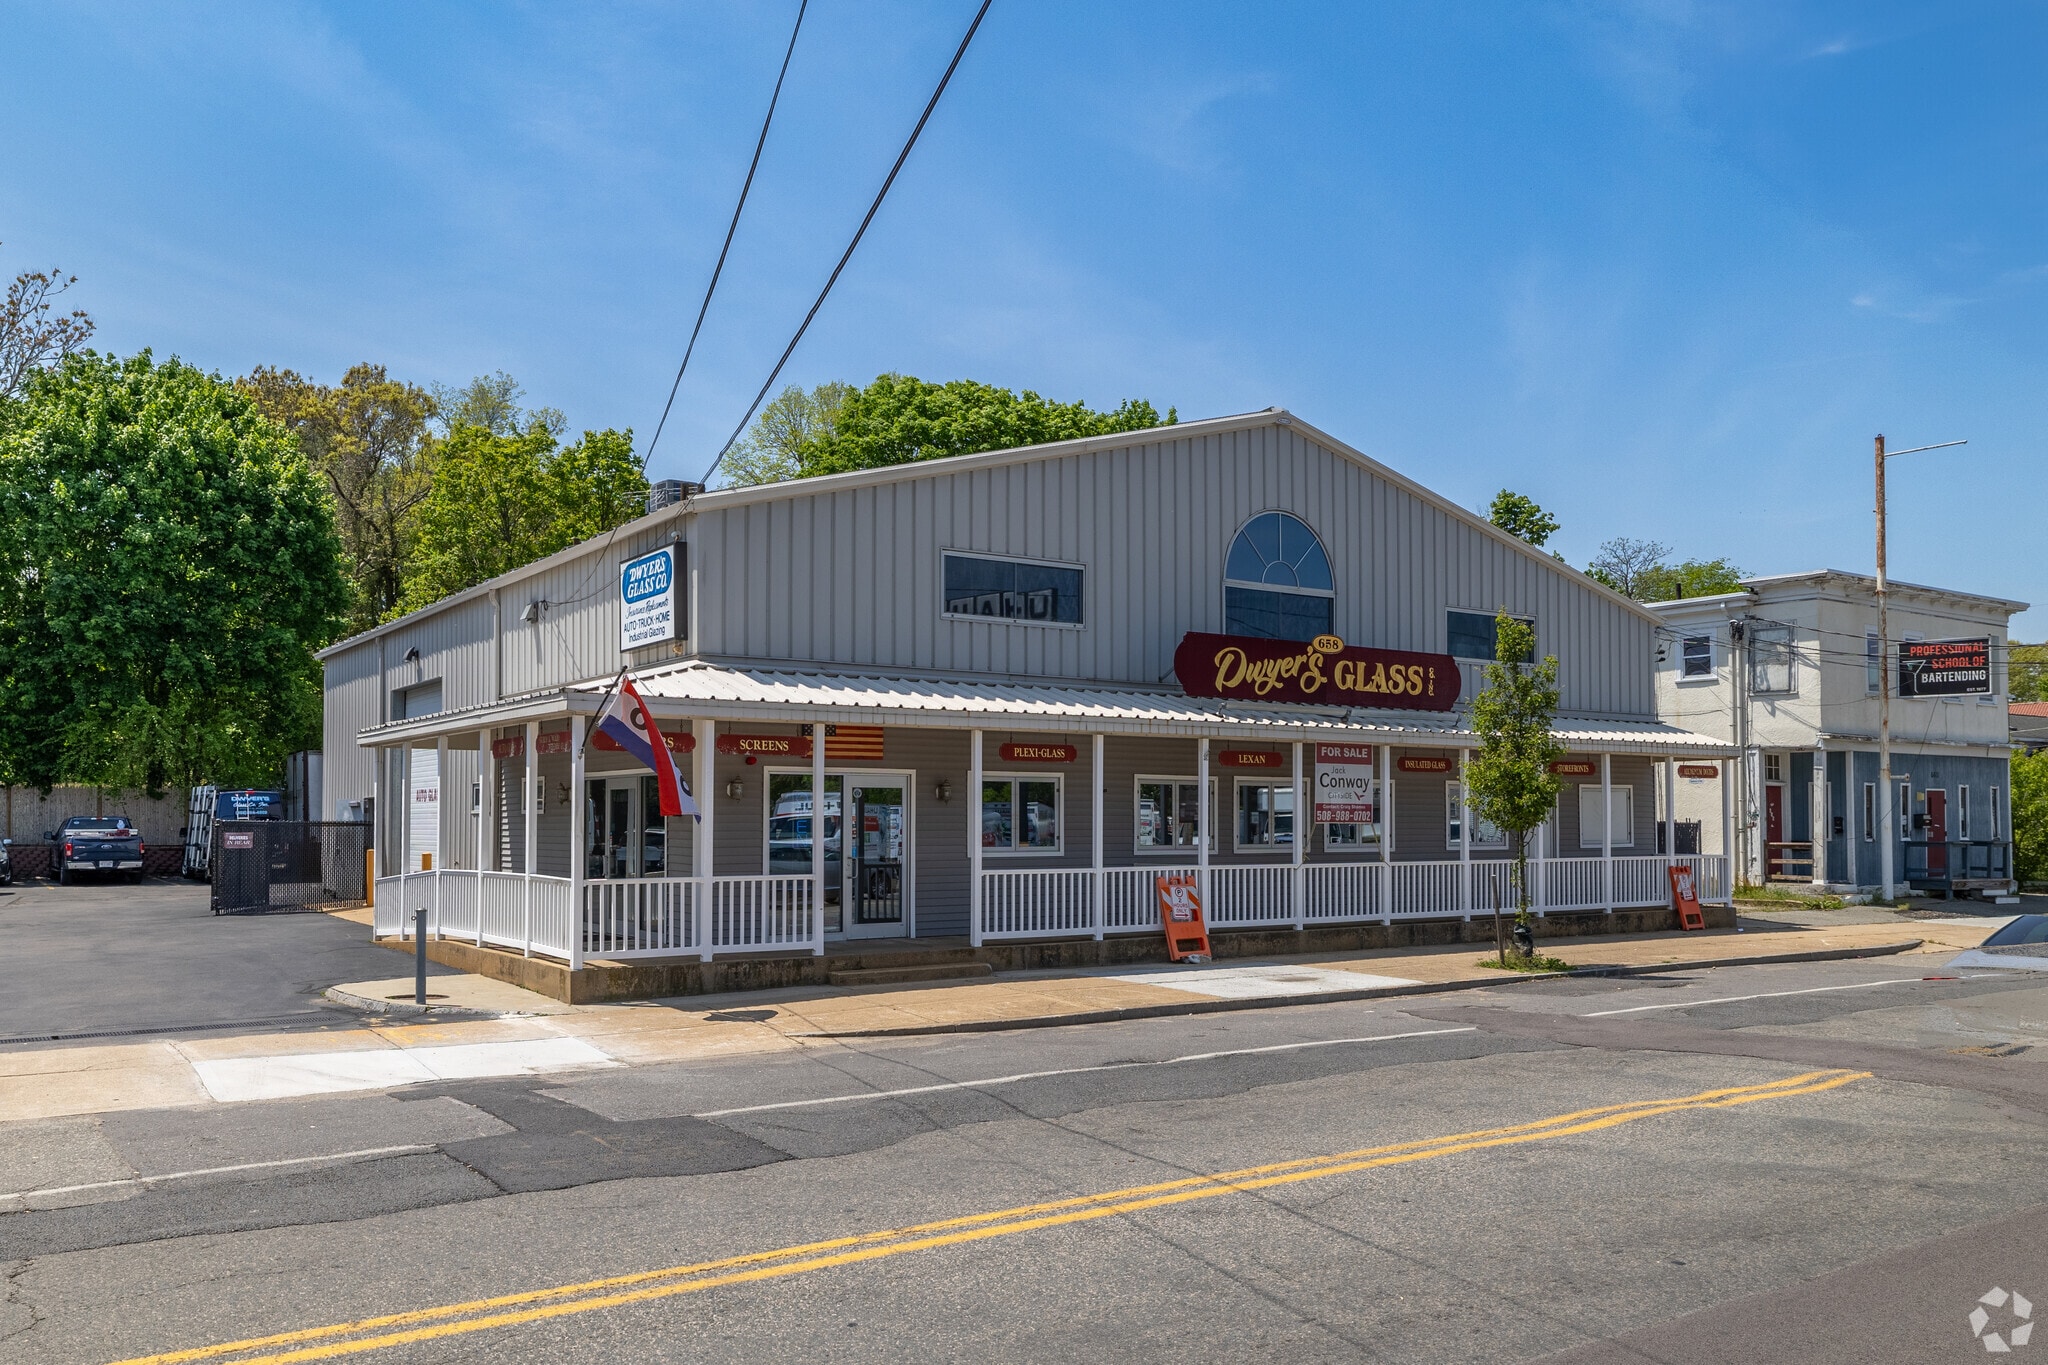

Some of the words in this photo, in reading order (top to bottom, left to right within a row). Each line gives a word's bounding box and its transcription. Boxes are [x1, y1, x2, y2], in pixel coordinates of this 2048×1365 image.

[627, 577, 655, 598] GLASS
[628, 628, 648, 643] Industrial
[648, 625, 666, 638] Glazing
[1318, 638, 1339, 650] 658
[1910, 642, 1983, 656] PROFESSIONAL
[1931, 657, 1971, 669] SCHOOL
[1973, 656, 1986, 667] OF
[1334, 660, 1424, 696] GLASS
[1921, 670, 1986, 683] BARTENDING
[740, 739, 789, 751] SCREENS
[1014, 747, 1066, 759] PLEXI-GLASS
[1321, 746, 1341, 757] FOR
[1343, 747, 1368, 758] SALE
[1238, 754, 1266, 764] LEXAN
[1405, 760, 1431, 769] INSULATED
[1431, 761, 1446, 769] GLASS
[1331, 765, 1346, 774] Jack
[1320, 772, 1370, 793] Conway
[1317, 810, 1370, 821] 508-988-0702
